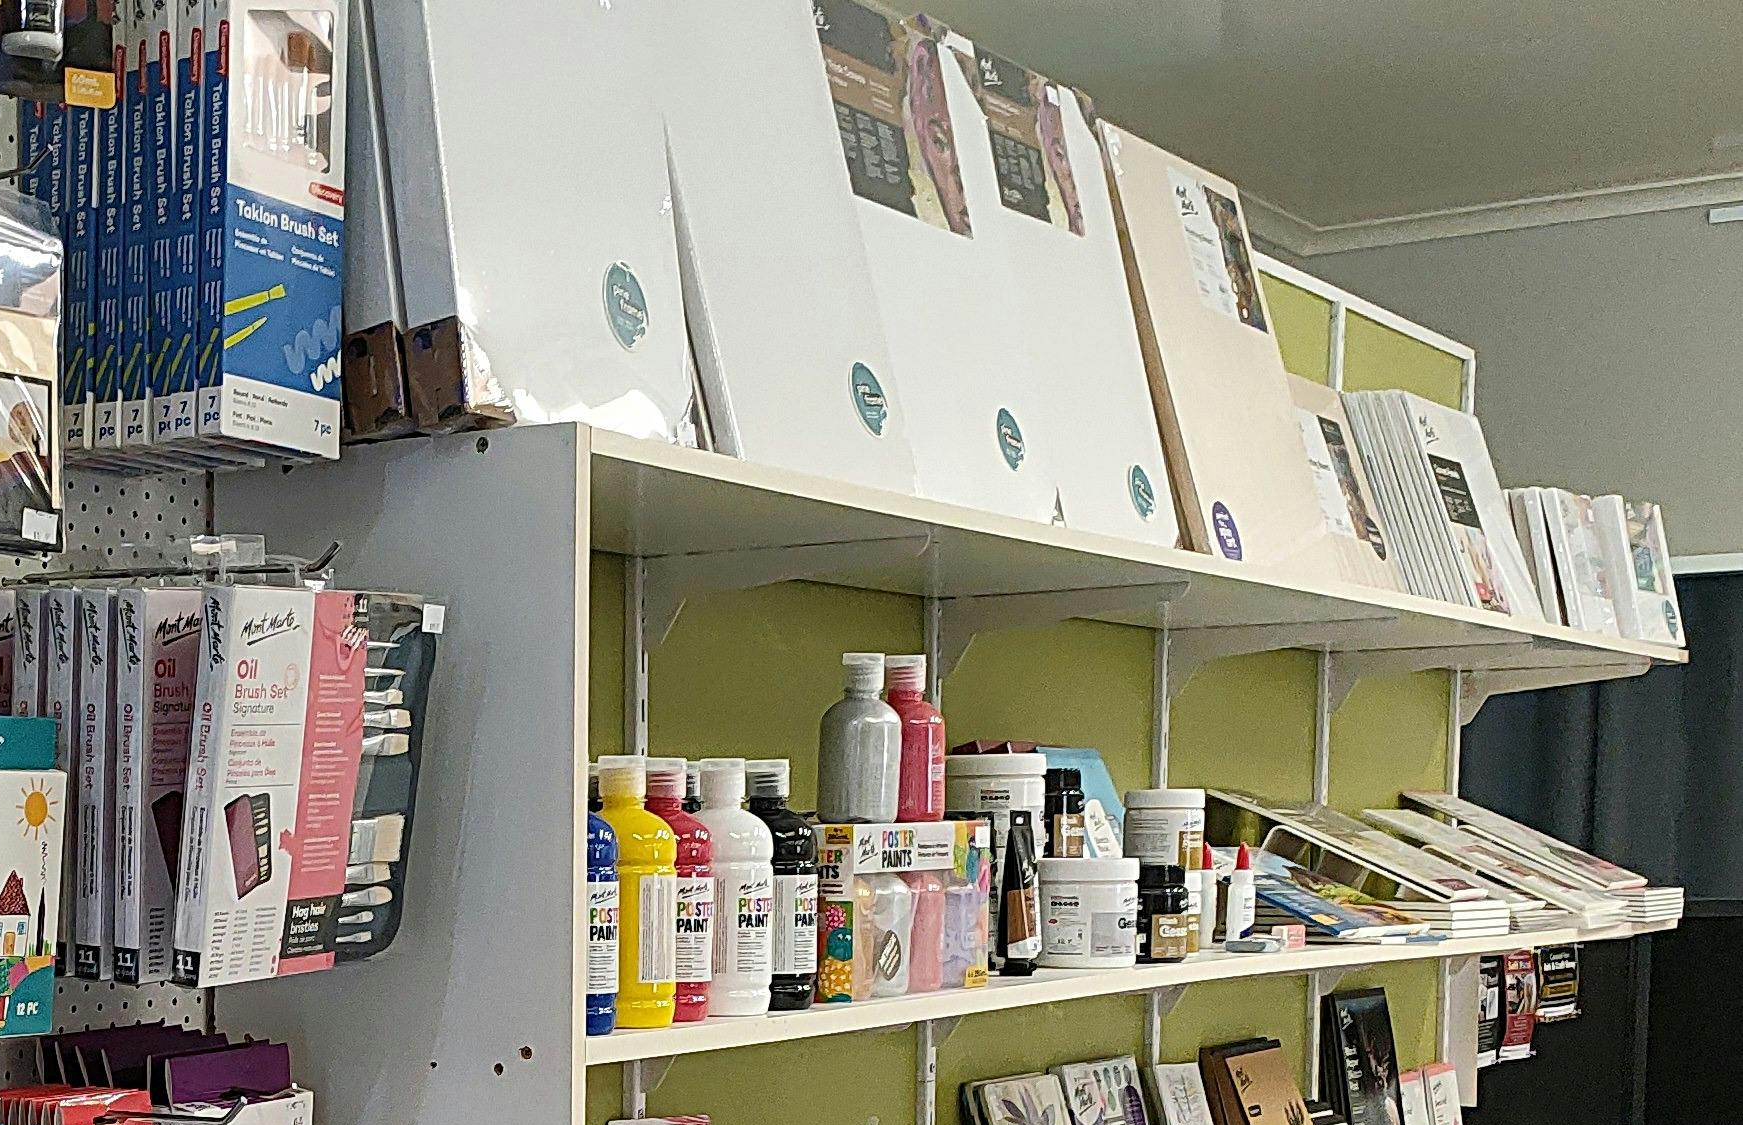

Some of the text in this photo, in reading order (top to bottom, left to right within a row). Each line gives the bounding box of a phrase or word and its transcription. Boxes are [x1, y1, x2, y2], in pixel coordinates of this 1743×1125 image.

[236, 200, 339, 247] Taklon Brush Set
[237, 659, 257, 679] Oil
[235, 683, 287, 700] Brush Set
[233, 702, 274, 715] Signature
[881, 829, 915, 848] POSTER
[881, 850, 912, 868] PAINTS
[676, 919, 708, 933] PAINT
[738, 914, 768, 928] PAINT
[16, 1002, 38, 1015] 12 PC
